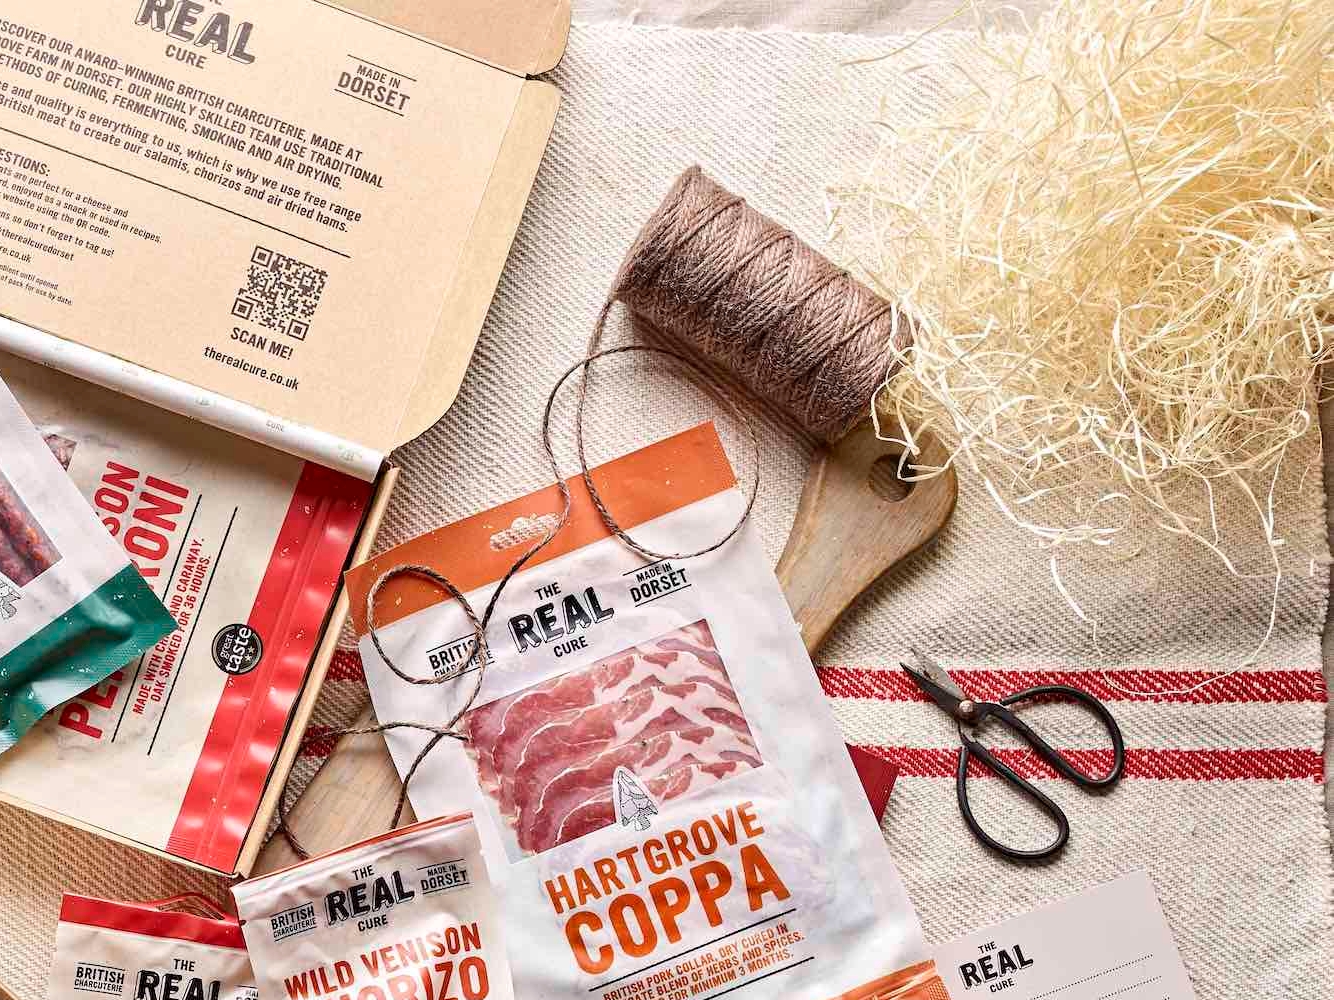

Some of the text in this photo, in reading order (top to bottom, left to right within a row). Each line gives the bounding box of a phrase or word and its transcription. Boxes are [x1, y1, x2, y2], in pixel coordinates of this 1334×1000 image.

[138, 0, 256, 65] REAL
[165, 44, 207, 70] CURE
[356, 64, 401, 89] MADE IN
[48, 37, 74, 56] OUR
[176, 83, 225, 110] BRITISH
[225, 101, 307, 144] CHARCUTERIE,
[309, 133, 345, 156] MADE
[344, 147, 363, 162] AT
[337, 71, 411, 111] DORSET
[204, 346, 299, 391] therealcure.co.uk
[176, 538, 205, 593] CARAWAY.
[183, 556, 211, 610] 36 HOURS.
[629, 567, 687, 603] DORSET
[534, 581, 562, 601] THE
[507, 586, 615, 654] REAL
[217, 631, 237, 660] great
[222, 624, 255, 674] taste
[553, 635, 589, 658] CURE
[132, 653, 163, 715] MADE WITH
[150, 634, 183, 703] OAK SMOKED
[351, 864, 375, 881] THE
[544, 807, 765, 915] HARTGROVE
[323, 870, 415, 927] REAL
[420, 868, 467, 895] DORSET
[270, 905, 315, 931] BRITISH
[357, 913, 389, 932] CURE
[564, 843, 792, 975] COPPA
[173, 958, 196, 972] THE
[283, 921, 482, 1000] WILD VENISON
[645, 968, 675, 988] PORK
[718, 941, 739, 959] DRY
[741, 928, 775, 949] CURED
[775, 922, 789, 936] IN
[959, 944, 1034, 988] REAL
[977, 940, 998, 954] THE
[74, 978, 123, 993] CHARCUTERIE
[75, 966, 125, 985] BRITISH
[989, 977, 1015, 993] CURE
